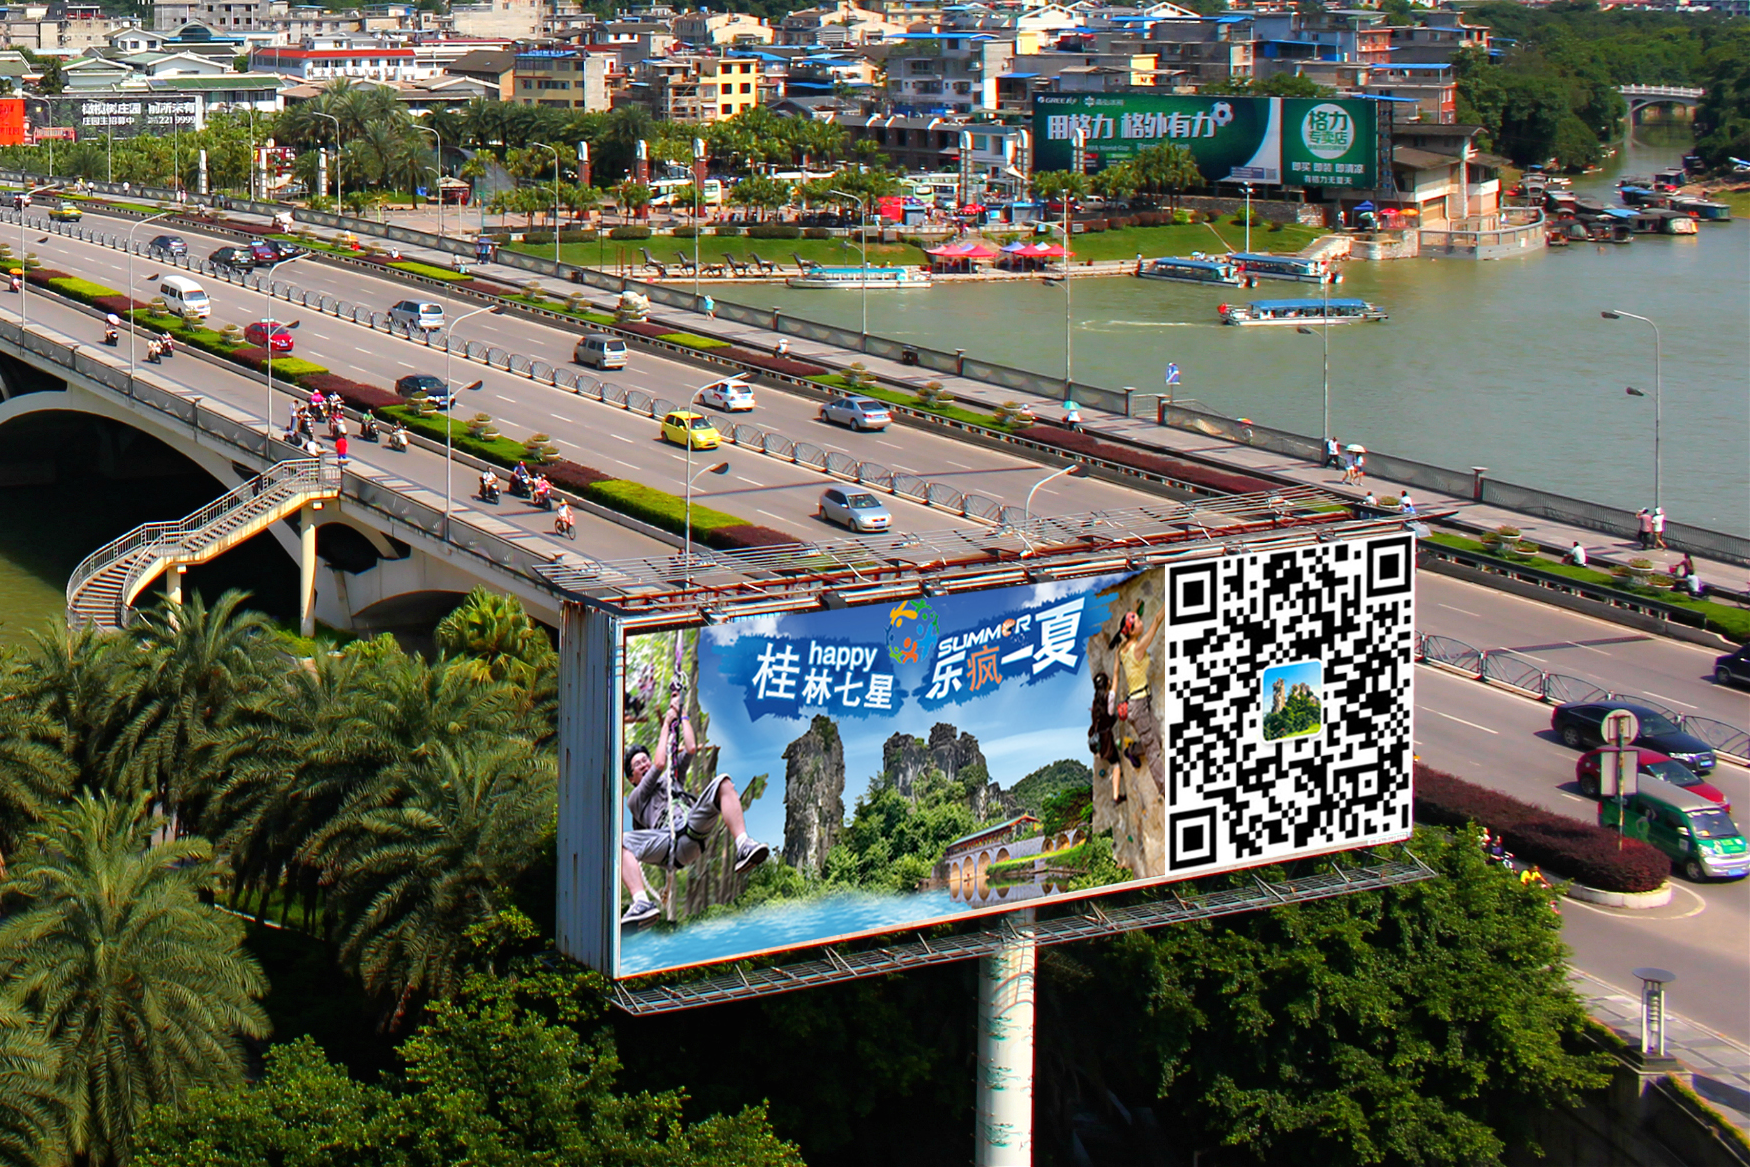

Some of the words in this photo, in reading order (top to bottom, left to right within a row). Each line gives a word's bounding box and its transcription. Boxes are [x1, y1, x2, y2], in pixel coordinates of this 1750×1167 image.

[82, 102, 142, 115] 橄榄树庄园
[148, 101, 196, 114] 前所未有
[1047, 113, 1115, 140] 用格力
[1120, 111, 1217, 140] 格外有力
[1309, 110, 1348, 131] 格力
[1309, 130, 1348, 145] 专卖店
[1292, 161, 1311, 172] 即买
[1304, 175, 1353, 185] 有格力无夏天
[808, 640, 878, 672] happy
[925, 597, 1085, 700] 乐疯一夏
[752, 642, 894, 710] 桂林七星
